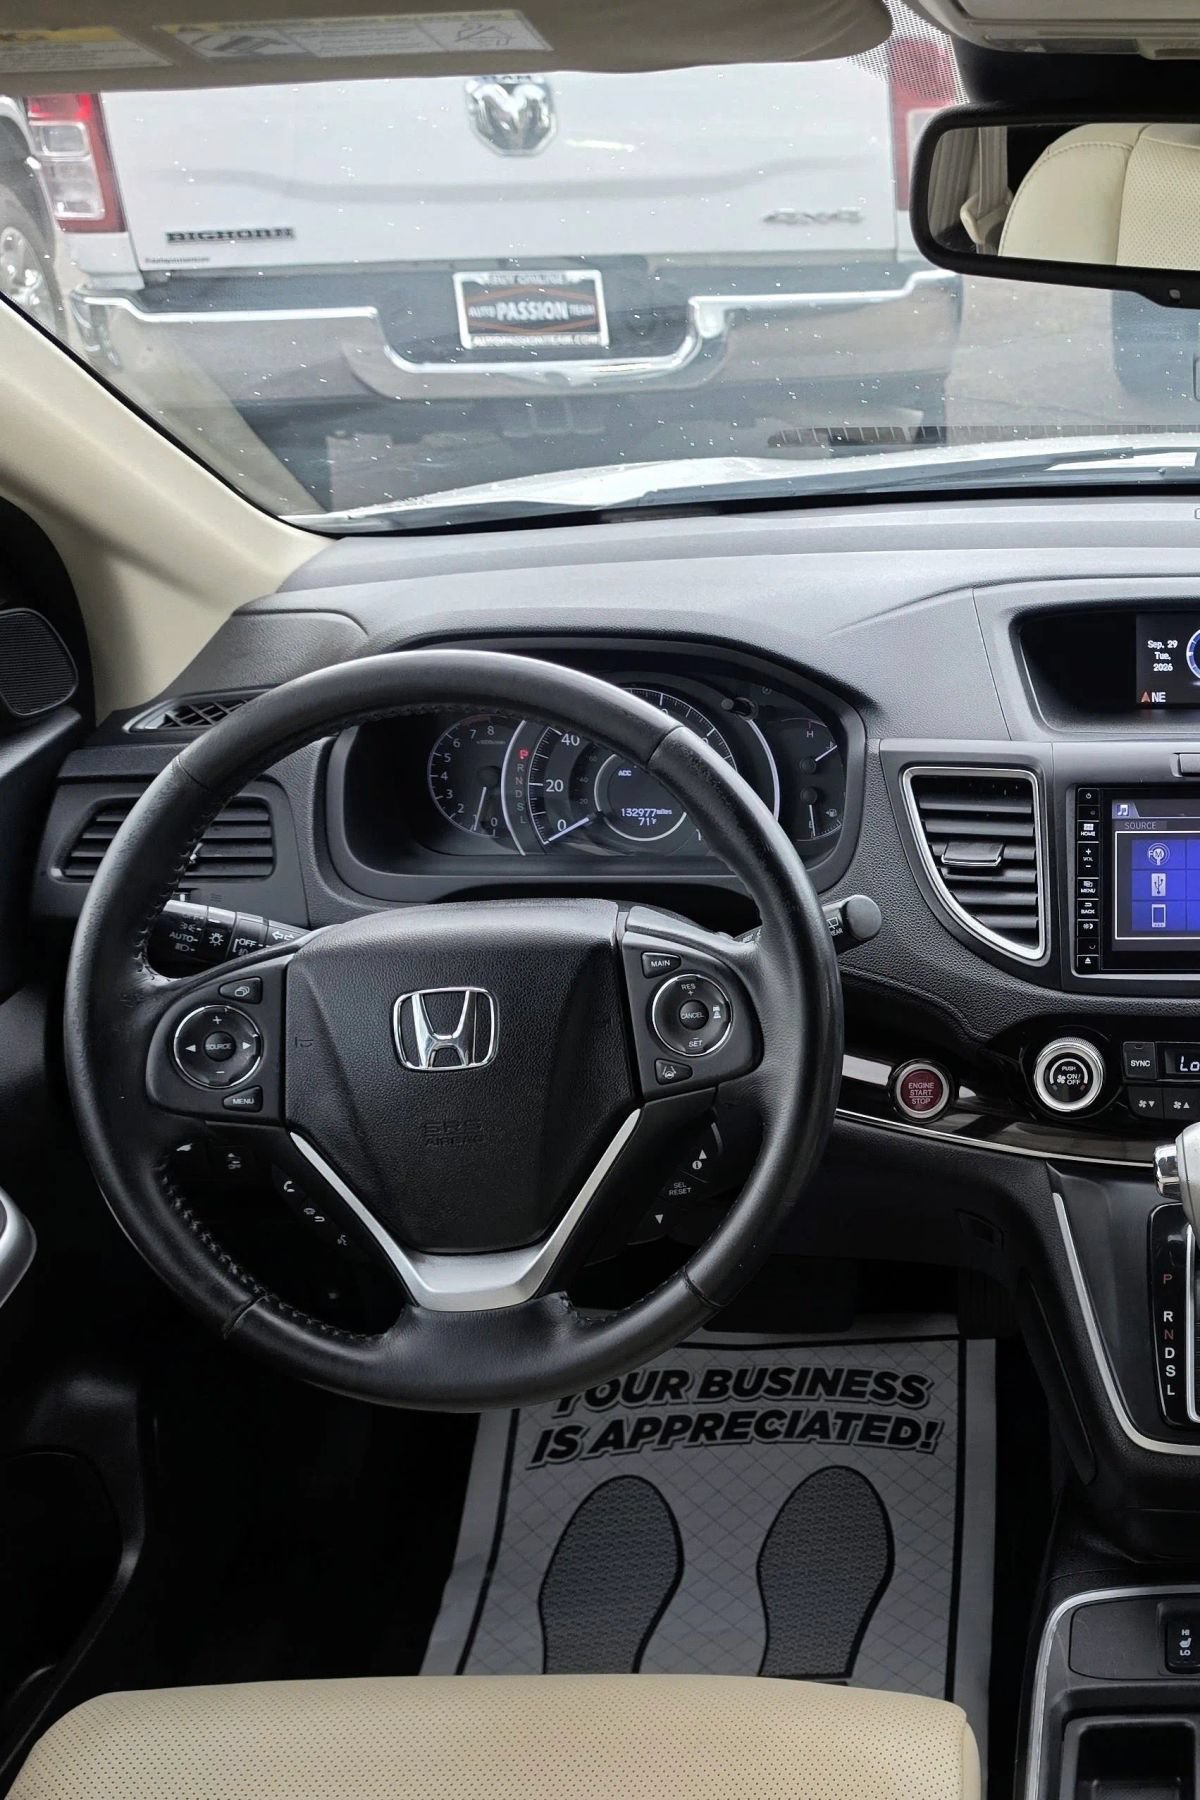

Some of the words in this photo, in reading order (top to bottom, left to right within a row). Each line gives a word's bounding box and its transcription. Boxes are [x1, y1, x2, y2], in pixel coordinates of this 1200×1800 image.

[496, 301, 569, 320] PASSION
[1148, 640, 1164, 649] Sep.
[1167, 640, 1178, 648] 29
[1153, 663, 1173, 671] 2026
[1152, 692, 1166, 702] NE
[470, 729, 477, 739] 7
[487, 725, 495, 735] 8
[453, 738, 461, 748] 6
[561, 733, 580, 746] 40
[444, 753, 451, 762] 5
[440, 771, 448, 780] 4
[545, 779, 564, 793] 20
[446, 789, 453, 798] 3
[458, 803, 464, 813] 2
[621, 808, 656, 817] 132977
[490, 817, 497, 827] 0
[557, 819, 567, 831] 0
[1124, 822, 1157, 830] SOURCE
[169, 931, 194, 943] AUTO
[239, 938, 257, 948] OFF
[681, 1012, 705, 1020] CANCEL
[689, 1040, 702, 1048] SET
[1130, 1059, 1151, 1067] SYNC
[1163, 1273, 1173, 1285] P
[1163, 1310, 1174, 1322] R
[1164, 1328, 1175, 1341] N
[1164, 1347, 1176, 1359] D
[1165, 1365, 1176, 1377] S
[696, 1366, 930, 1406] BUSINESS
[1167, 1384, 1175, 1396] L
[530, 1424, 585, 1464] IS
[586, 1408, 939, 1455] APPRECIATED!
